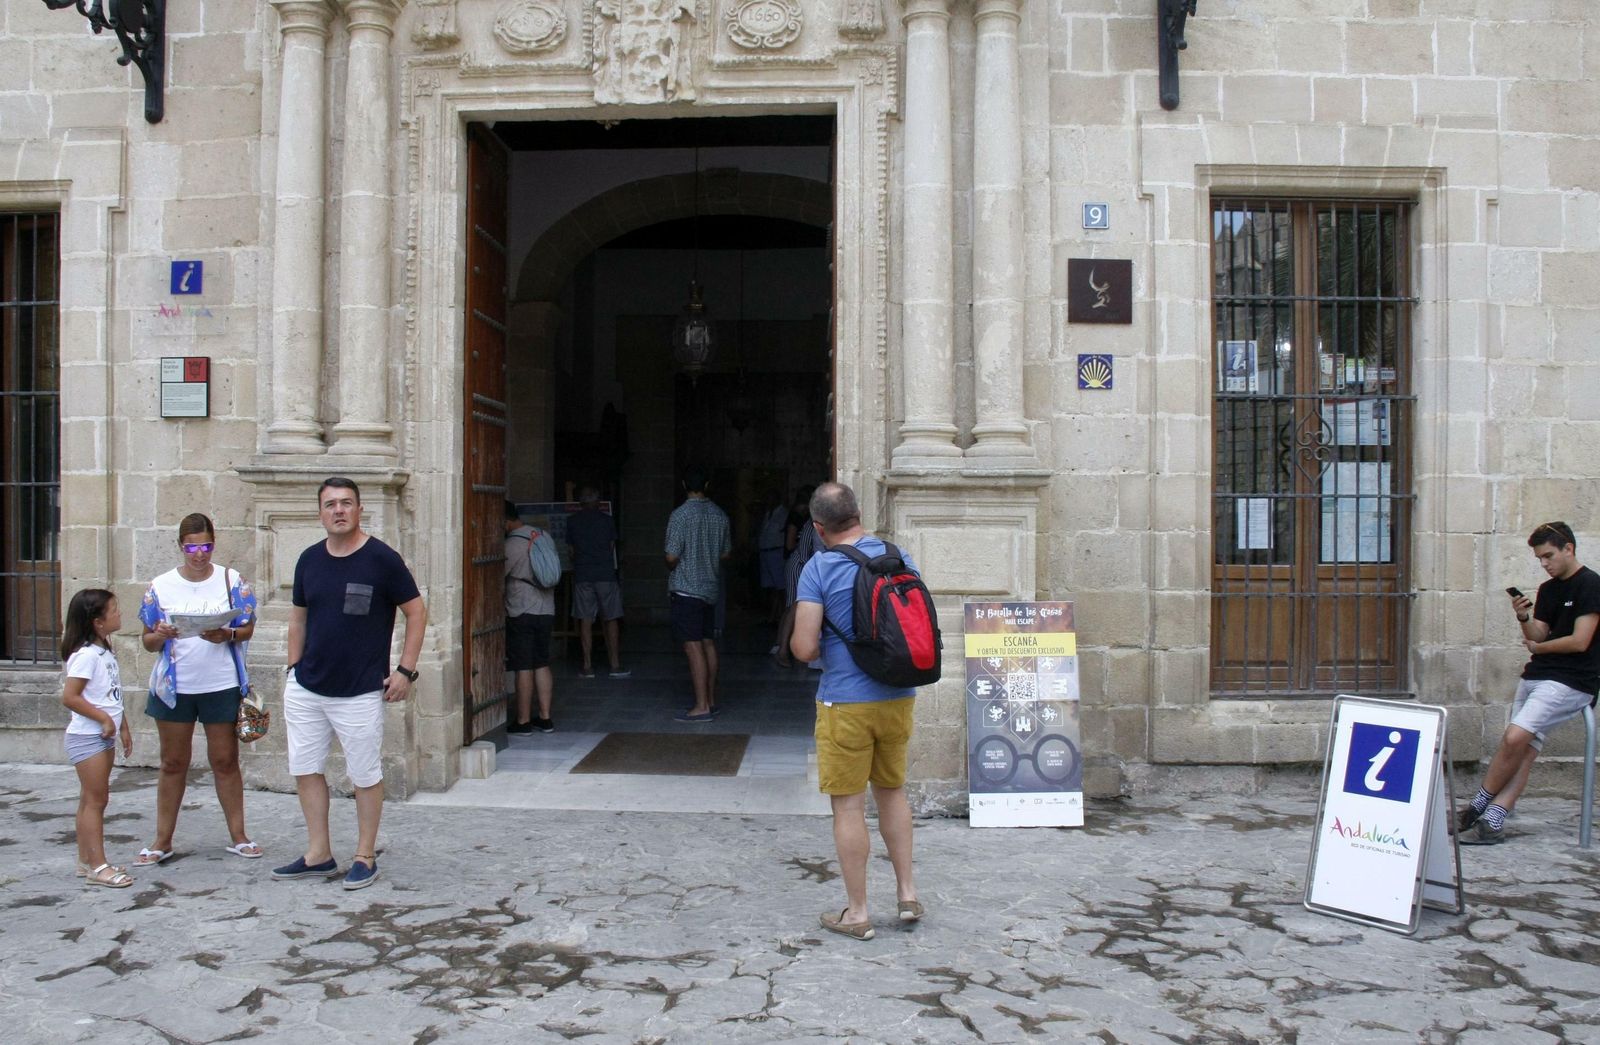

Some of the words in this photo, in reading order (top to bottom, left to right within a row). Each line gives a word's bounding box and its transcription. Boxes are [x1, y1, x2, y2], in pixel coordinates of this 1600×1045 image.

[1090, 207, 1102, 225] 9
[1026, 607, 1037, 617] las
[1007, 647, 1037, 655] DESCUENTO
[1364, 730, 1402, 792] i
[1329, 815, 1410, 851] Andalucía
